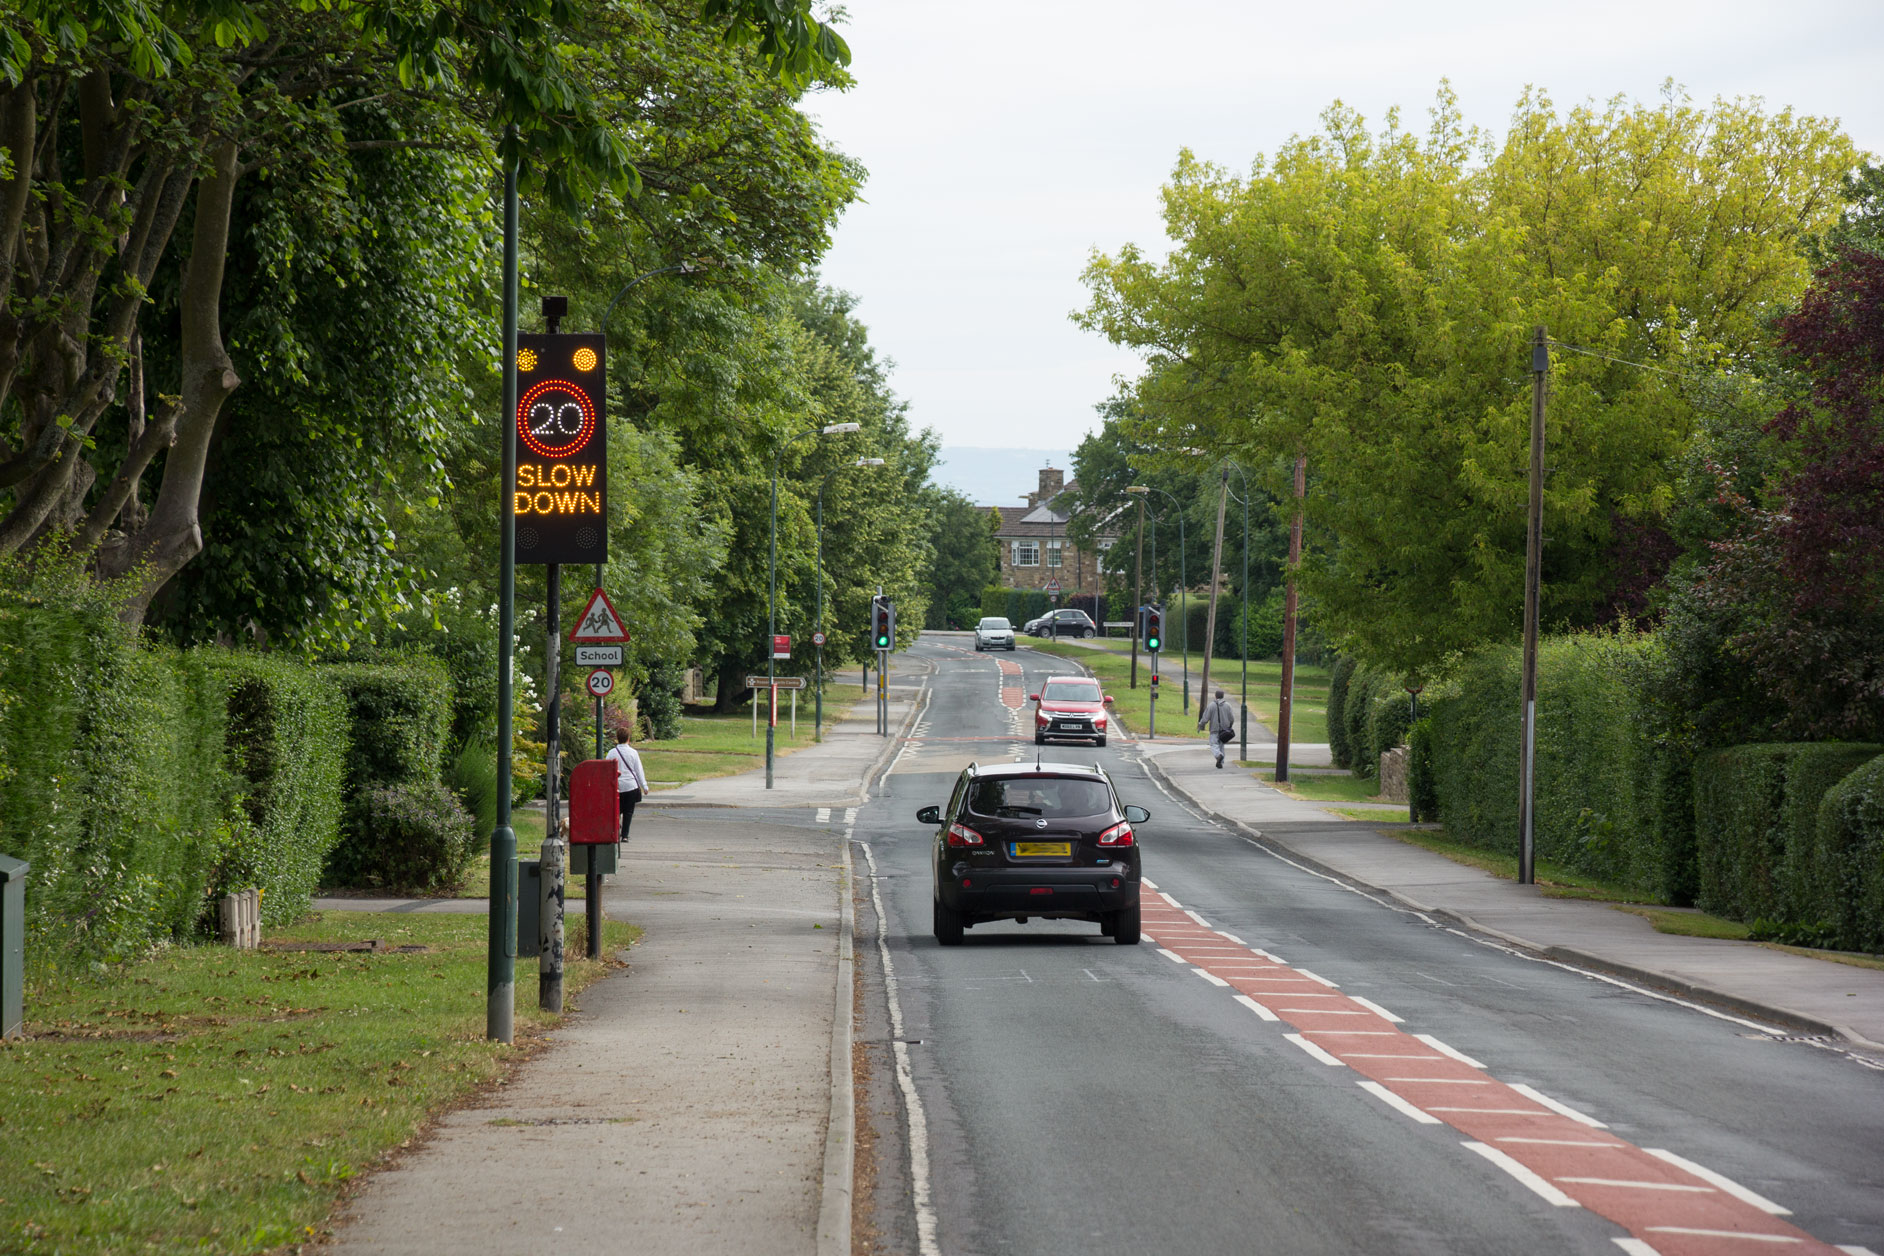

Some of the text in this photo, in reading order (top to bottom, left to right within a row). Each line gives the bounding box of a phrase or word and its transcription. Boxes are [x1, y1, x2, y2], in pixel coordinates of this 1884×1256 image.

[530, 402, 584, 435] 20
[517, 464, 597, 487] SLOW
[514, 491, 600, 514] DOWN
[580, 651, 618, 660] School
[591, 676, 610, 688] 20
